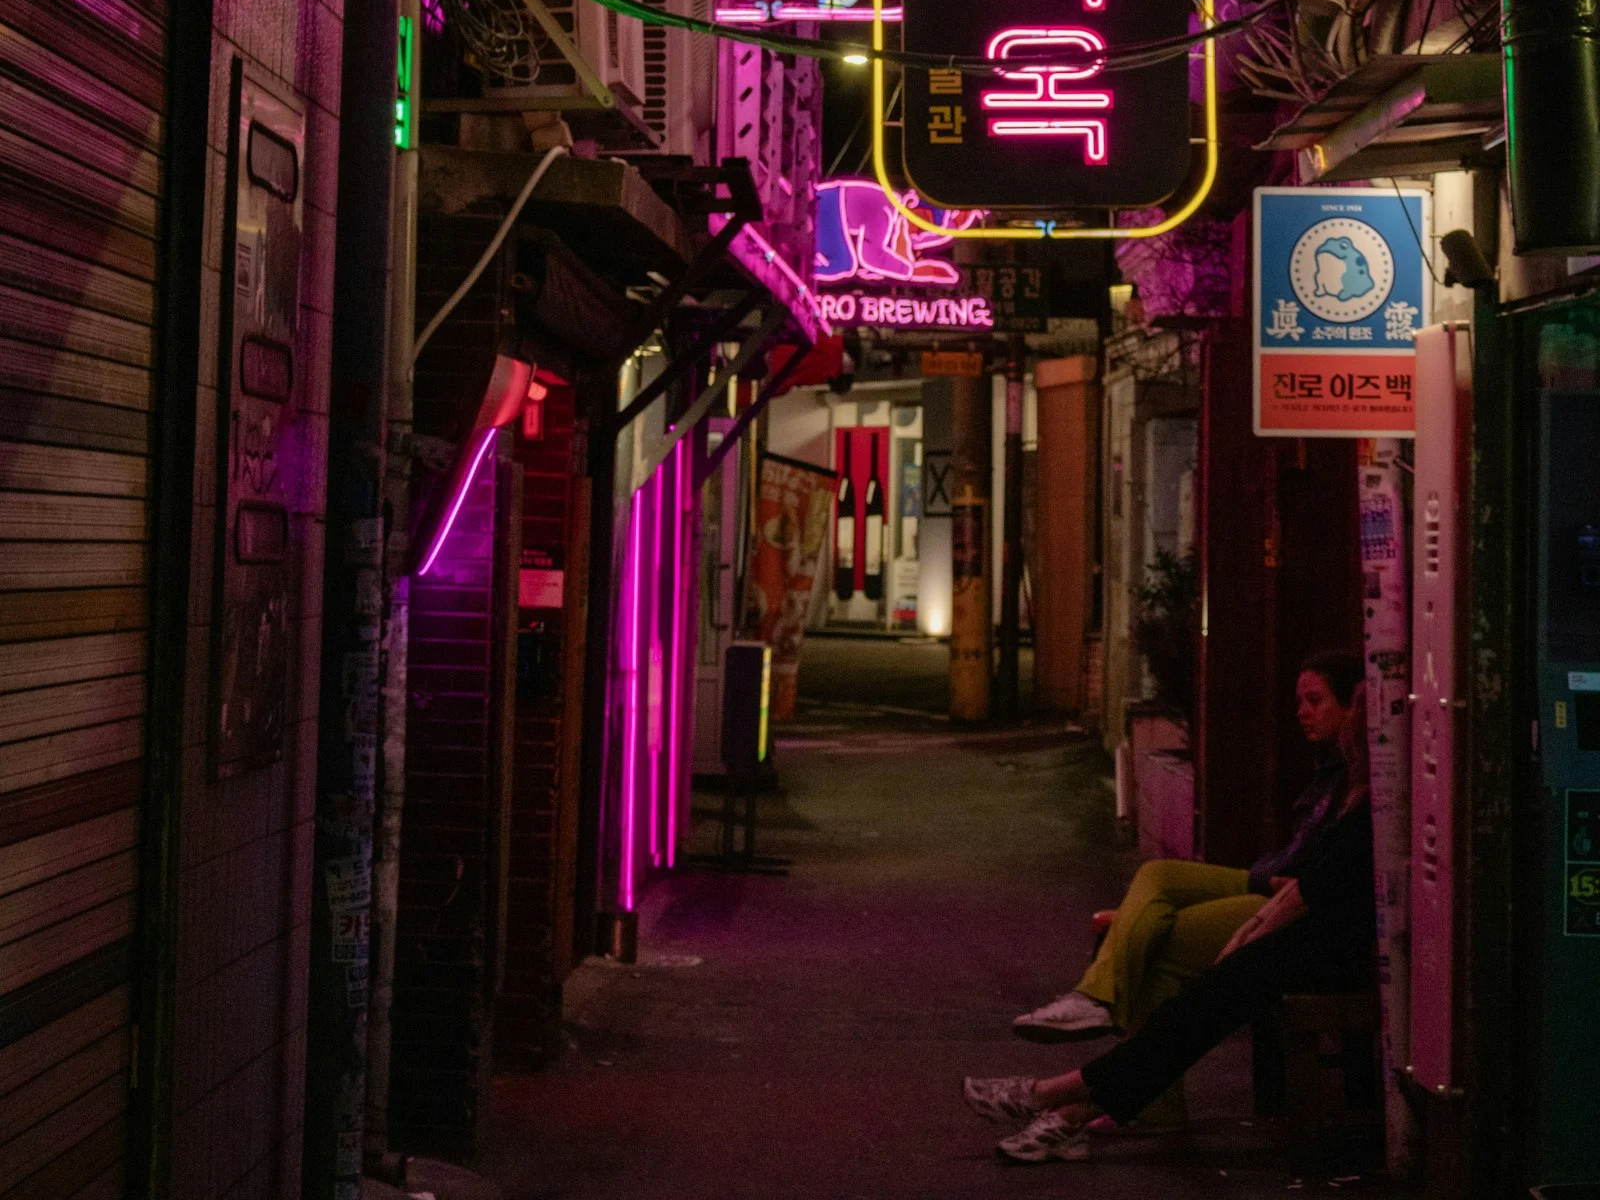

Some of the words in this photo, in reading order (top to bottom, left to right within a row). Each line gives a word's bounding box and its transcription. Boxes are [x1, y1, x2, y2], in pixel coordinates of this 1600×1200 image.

[816, 294, 856, 321] RO
[859, 297, 994, 327] BREWING
[1272, 373, 1322, 400] 진로
[1330, 373, 1381, 400] 이즈
[1385, 373, 1412, 401] 백
